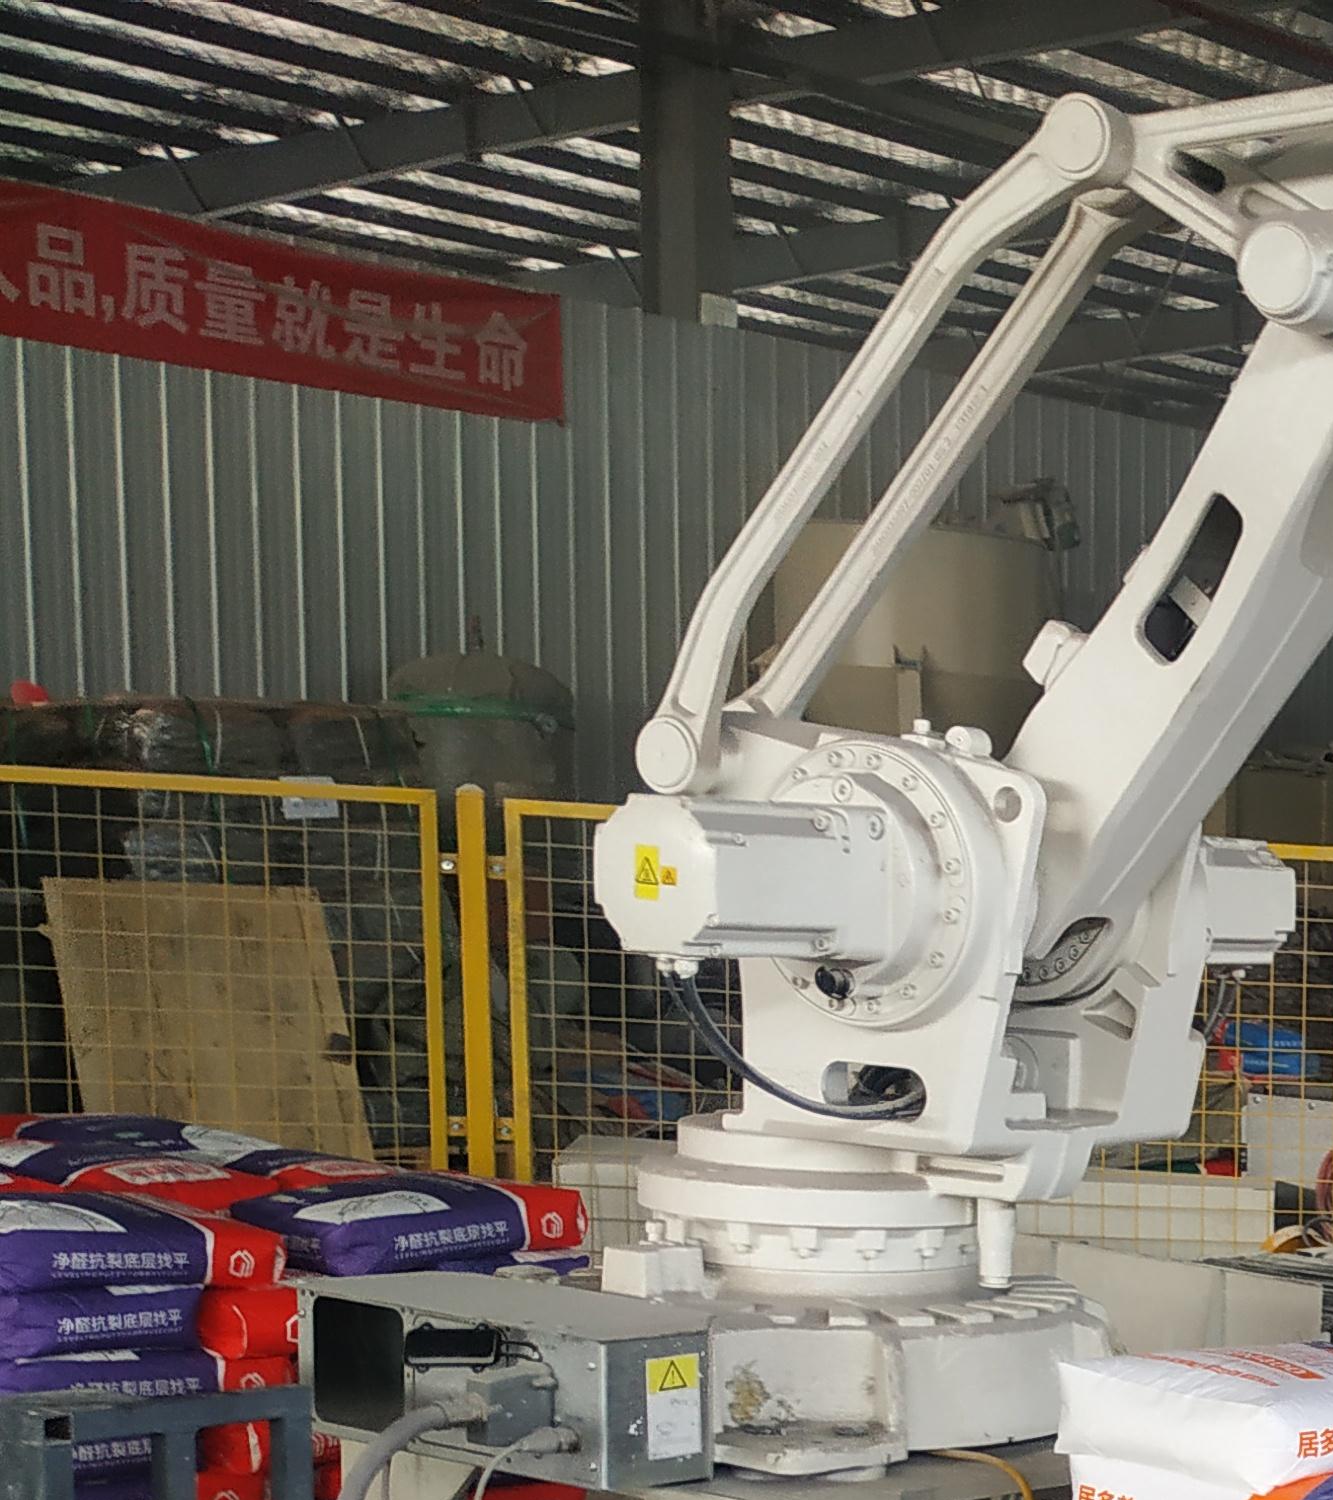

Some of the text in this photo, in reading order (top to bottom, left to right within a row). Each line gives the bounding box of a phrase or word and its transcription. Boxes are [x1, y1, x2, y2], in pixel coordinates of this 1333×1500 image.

[53, 1251, 190, 1271] 净醛抗裂底层找平
[57, 1308, 183, 1336] 净醛抗裂底层找平
